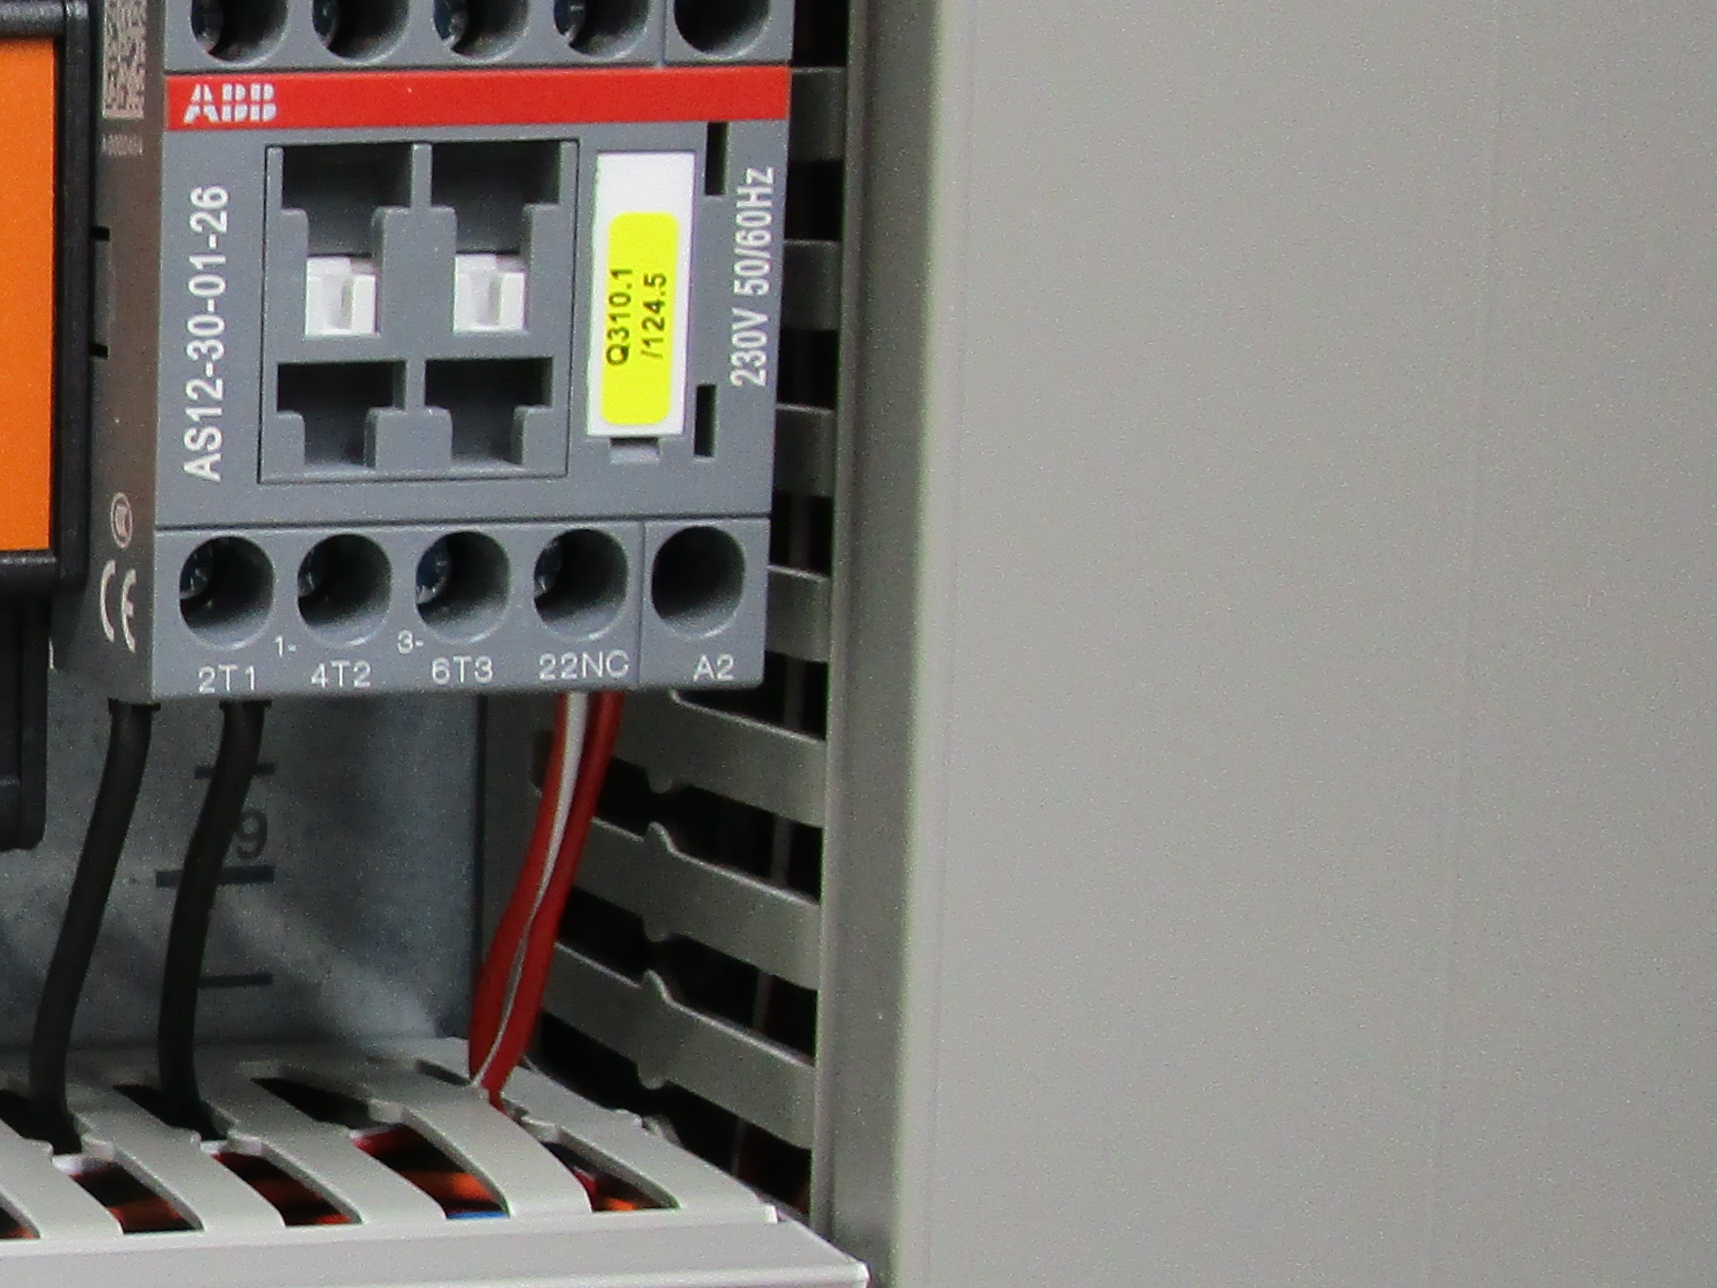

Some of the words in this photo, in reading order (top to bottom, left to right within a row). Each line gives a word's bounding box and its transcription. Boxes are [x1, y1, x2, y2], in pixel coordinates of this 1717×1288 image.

[184, 84, 276, 124] ABB
[733, 167, 776, 300] 50/60Hz
[183, 185, 229, 483] AS12-30-01-26
[606, 266, 636, 367] Q310.1
[641, 271, 669, 362] /124.5
[729, 308, 768, 388] 230V
[197, 665, 257, 694] 2T1
[310, 660, 372, 688] 4T2
[431, 657, 493, 685] 6T3
[538, 651, 630, 680] 22NC
[693, 653, 735, 682] A2
